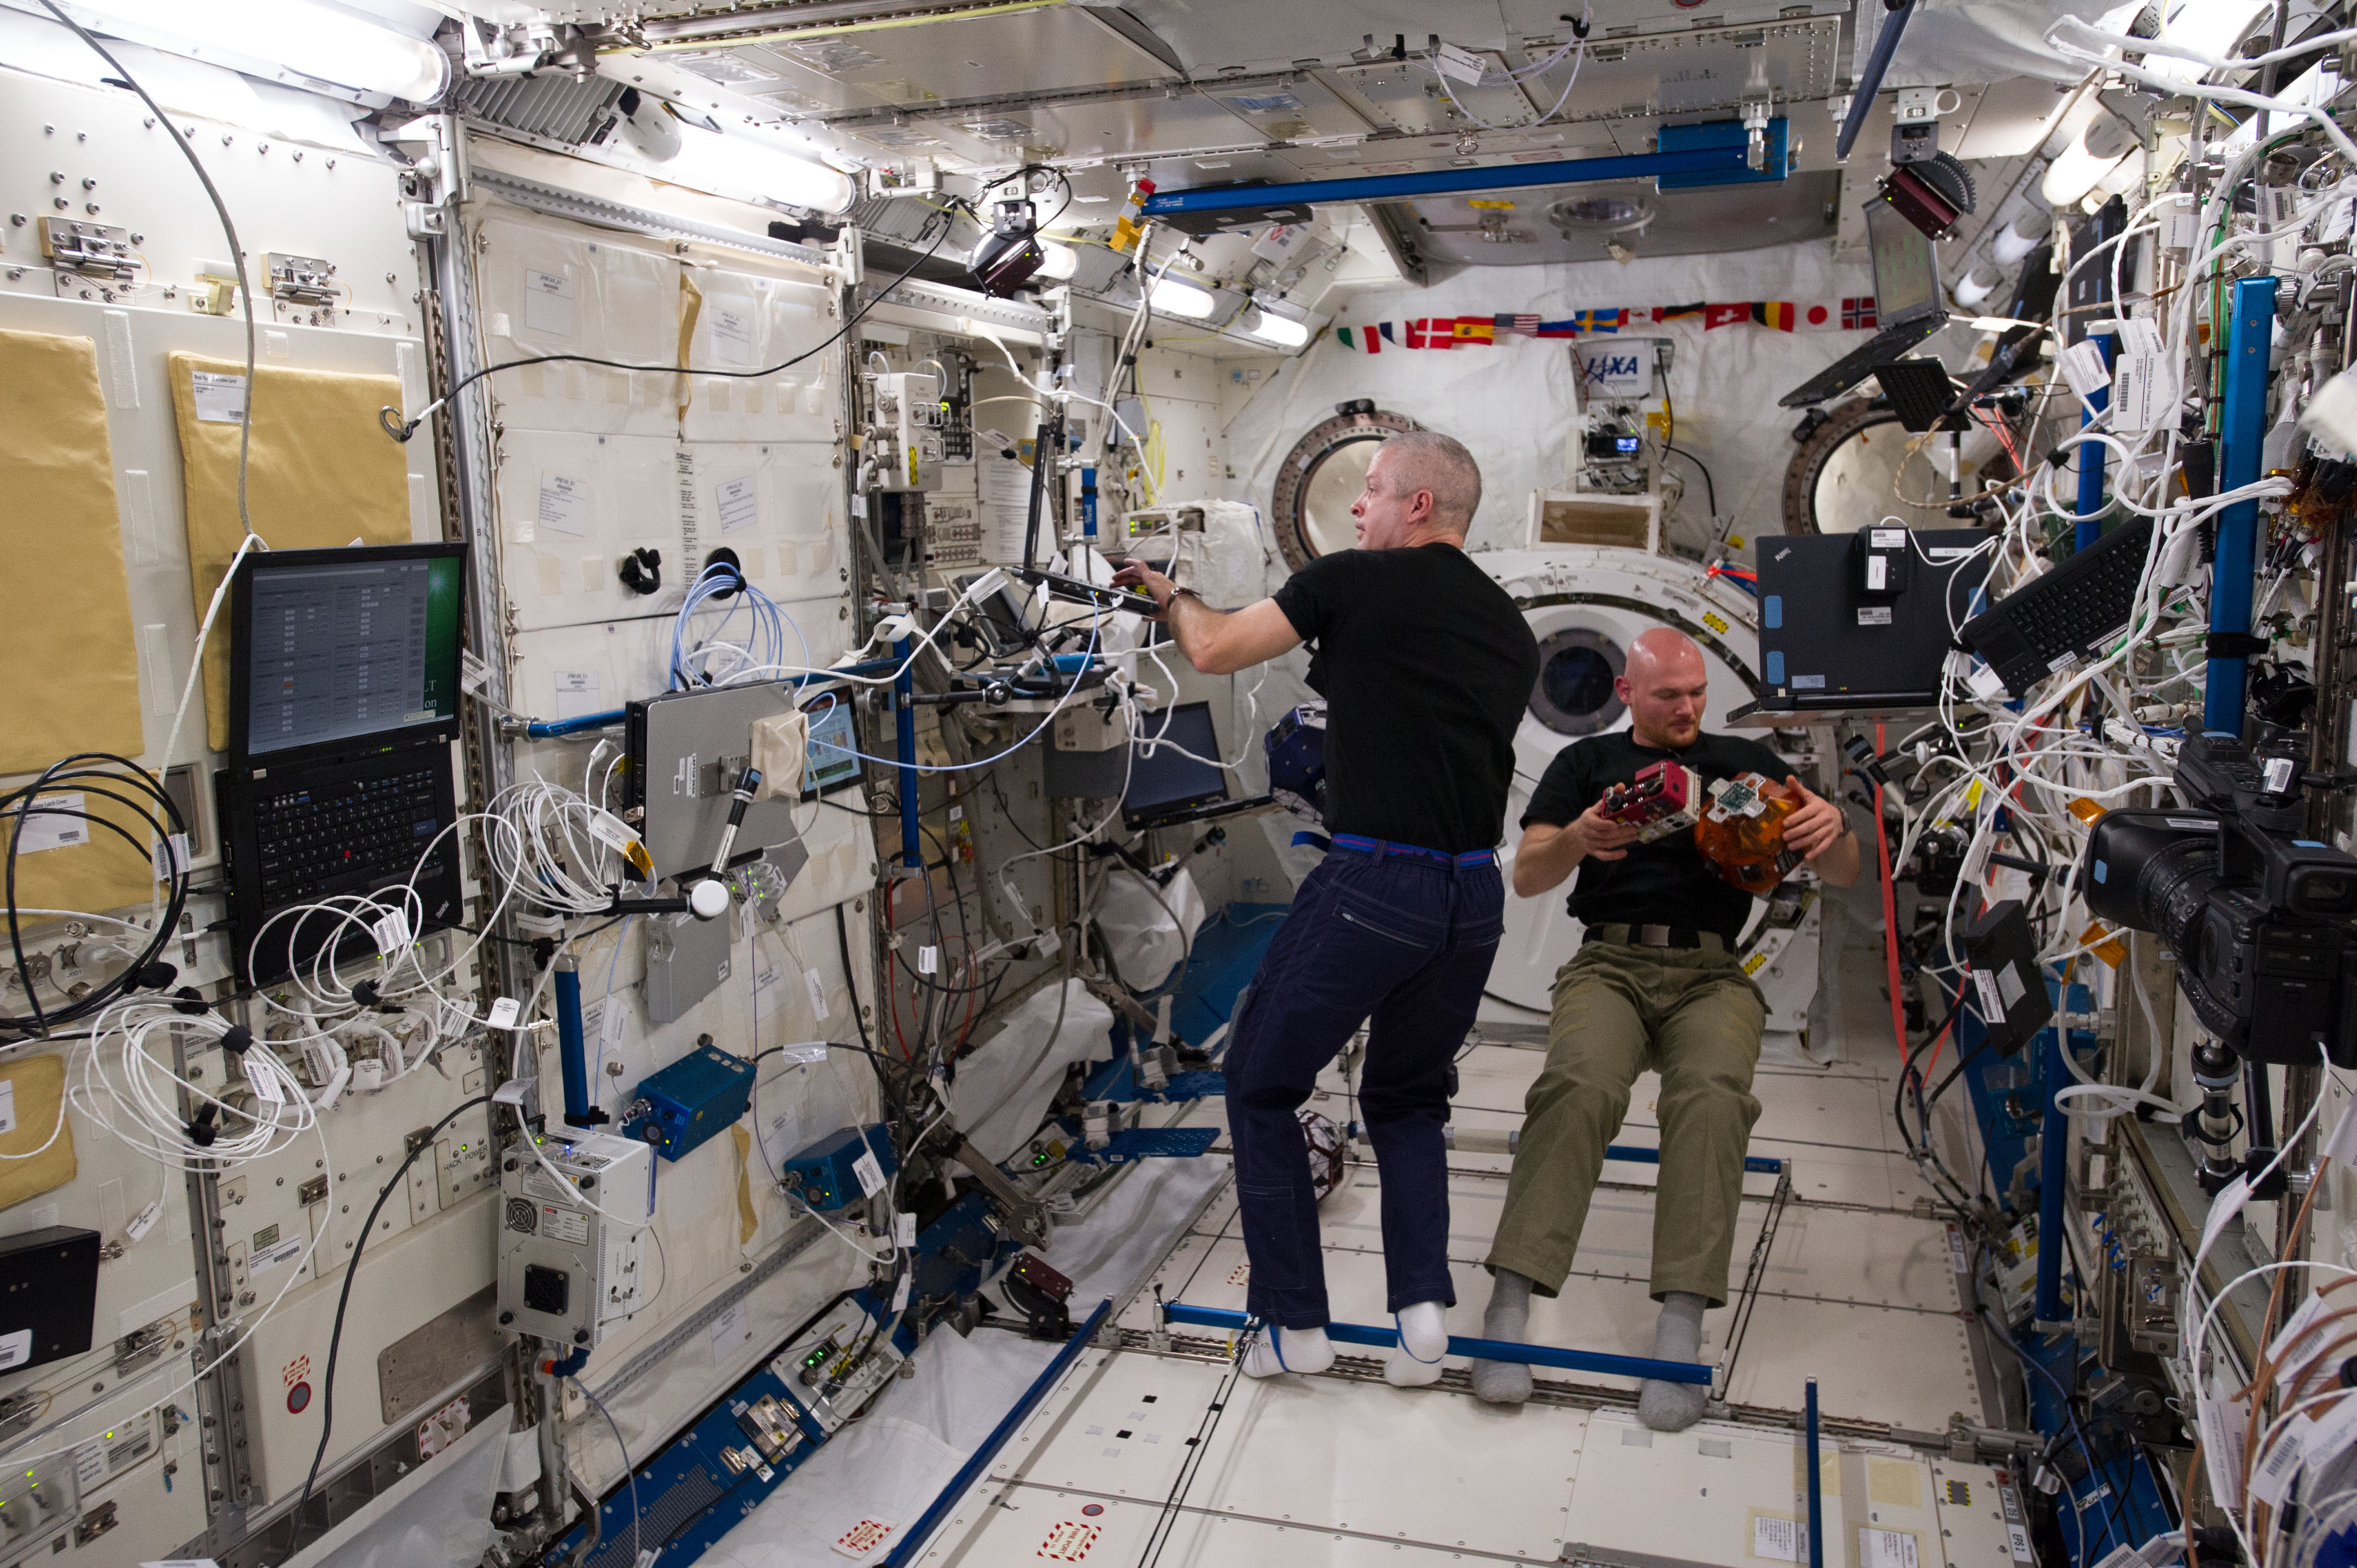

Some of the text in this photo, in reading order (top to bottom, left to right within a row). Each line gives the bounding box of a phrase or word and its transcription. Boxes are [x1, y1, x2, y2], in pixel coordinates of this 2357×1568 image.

[1586, 355, 1638, 381] JAXA
[444, 1146, 487, 1171] RACK POWER
[1059, 1528, 1080, 1554] FIRE PORT
[2013, 1533, 2025, 1546] EPS
